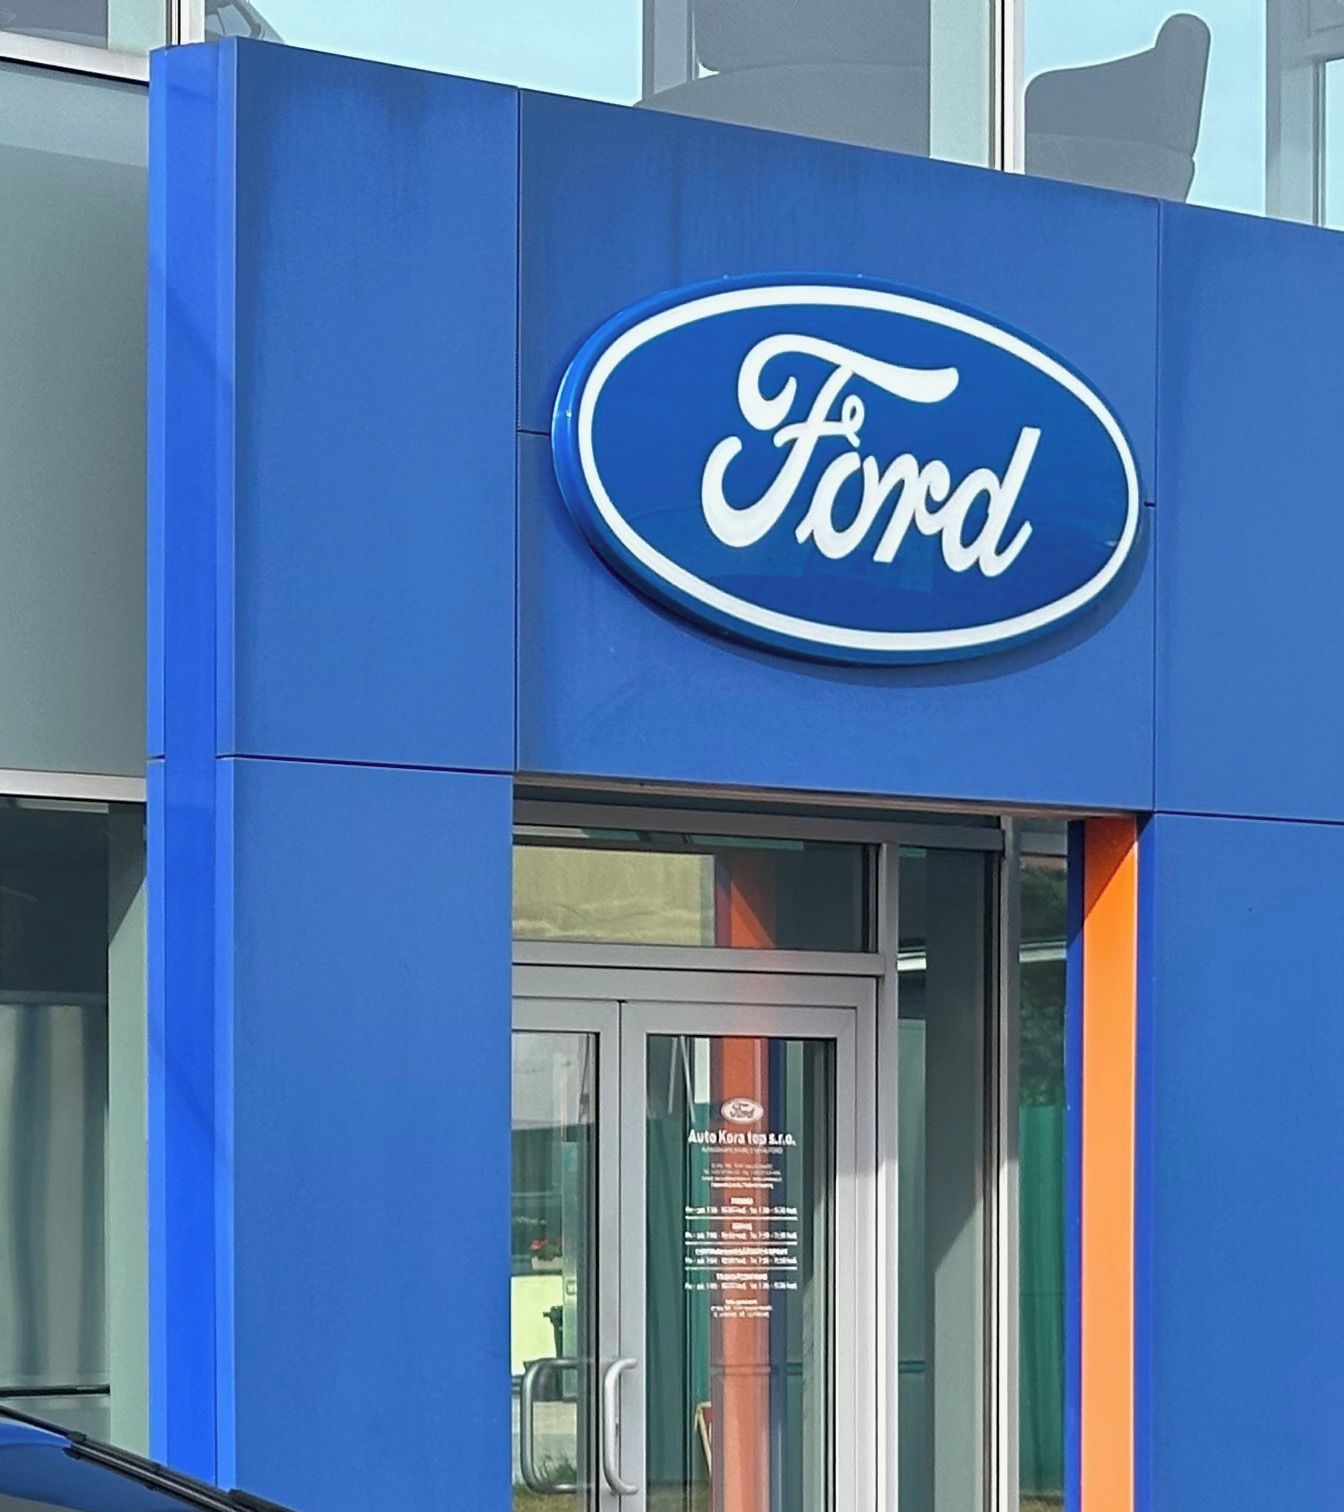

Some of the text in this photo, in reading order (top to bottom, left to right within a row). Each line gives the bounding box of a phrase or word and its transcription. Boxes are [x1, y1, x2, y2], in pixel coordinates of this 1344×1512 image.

[702, 333, 1042, 577] Ford
[687, 1128, 718, 1144] Auto
[718, 1129, 746, 1145] Kora
[768, 1132, 797, 1146] s.r.o.
